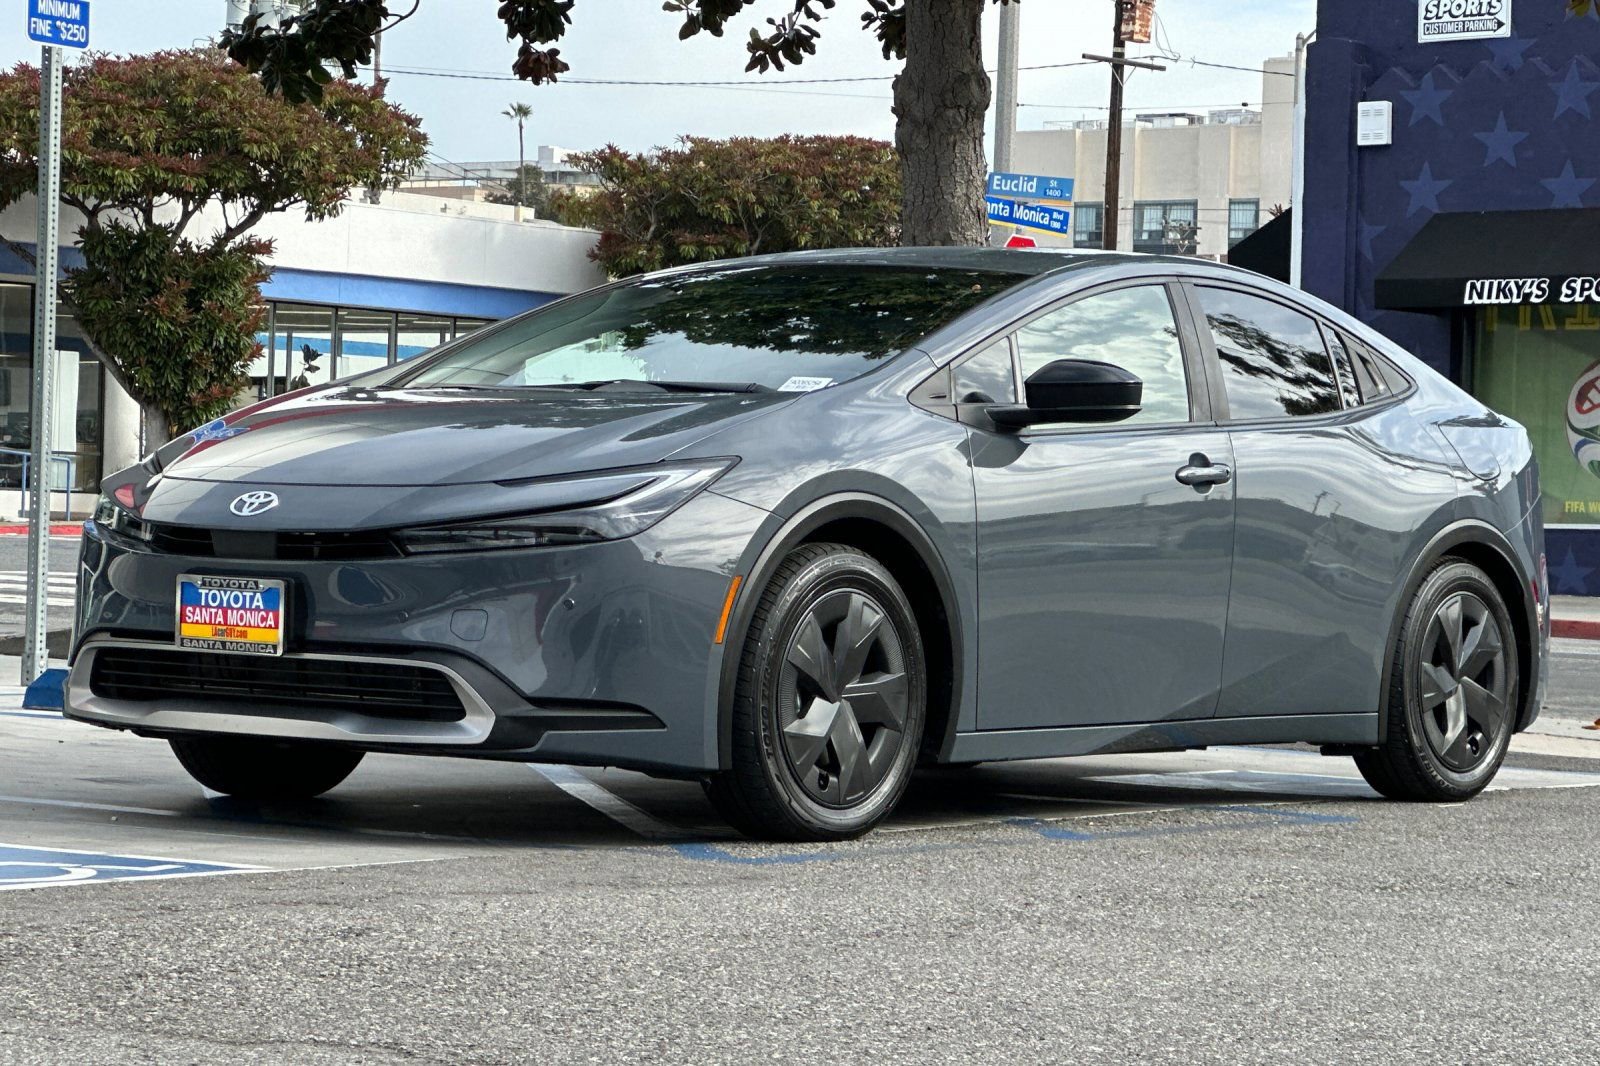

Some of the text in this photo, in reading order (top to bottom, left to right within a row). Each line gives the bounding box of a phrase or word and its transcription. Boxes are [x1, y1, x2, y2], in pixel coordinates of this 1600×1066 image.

[38, 0, 80, 20] MINIMUM
[1424, 0, 1502, 20] SPORTS
[31, 18, 86, 42] FINE $250
[1424, 20, 1497, 34] CUSTOMER PARKING
[993, 175, 1058, 192] Euclid St
[1045, 188, 1061, 197] 1400
[1013, 204, 1050, 224] Monica
[1052, 211, 1064, 220] Blvd
[1463, 278, 1549, 304] NIKY'S
[1565, 500, 1585, 513] FIFA
[202, 578, 256, 589] TOYOTA
[198, 589, 264, 609] TOYOTA
[186, 606, 275, 628] SANTA MONICA
[183, 638, 274, 653] SANTA MONICA
